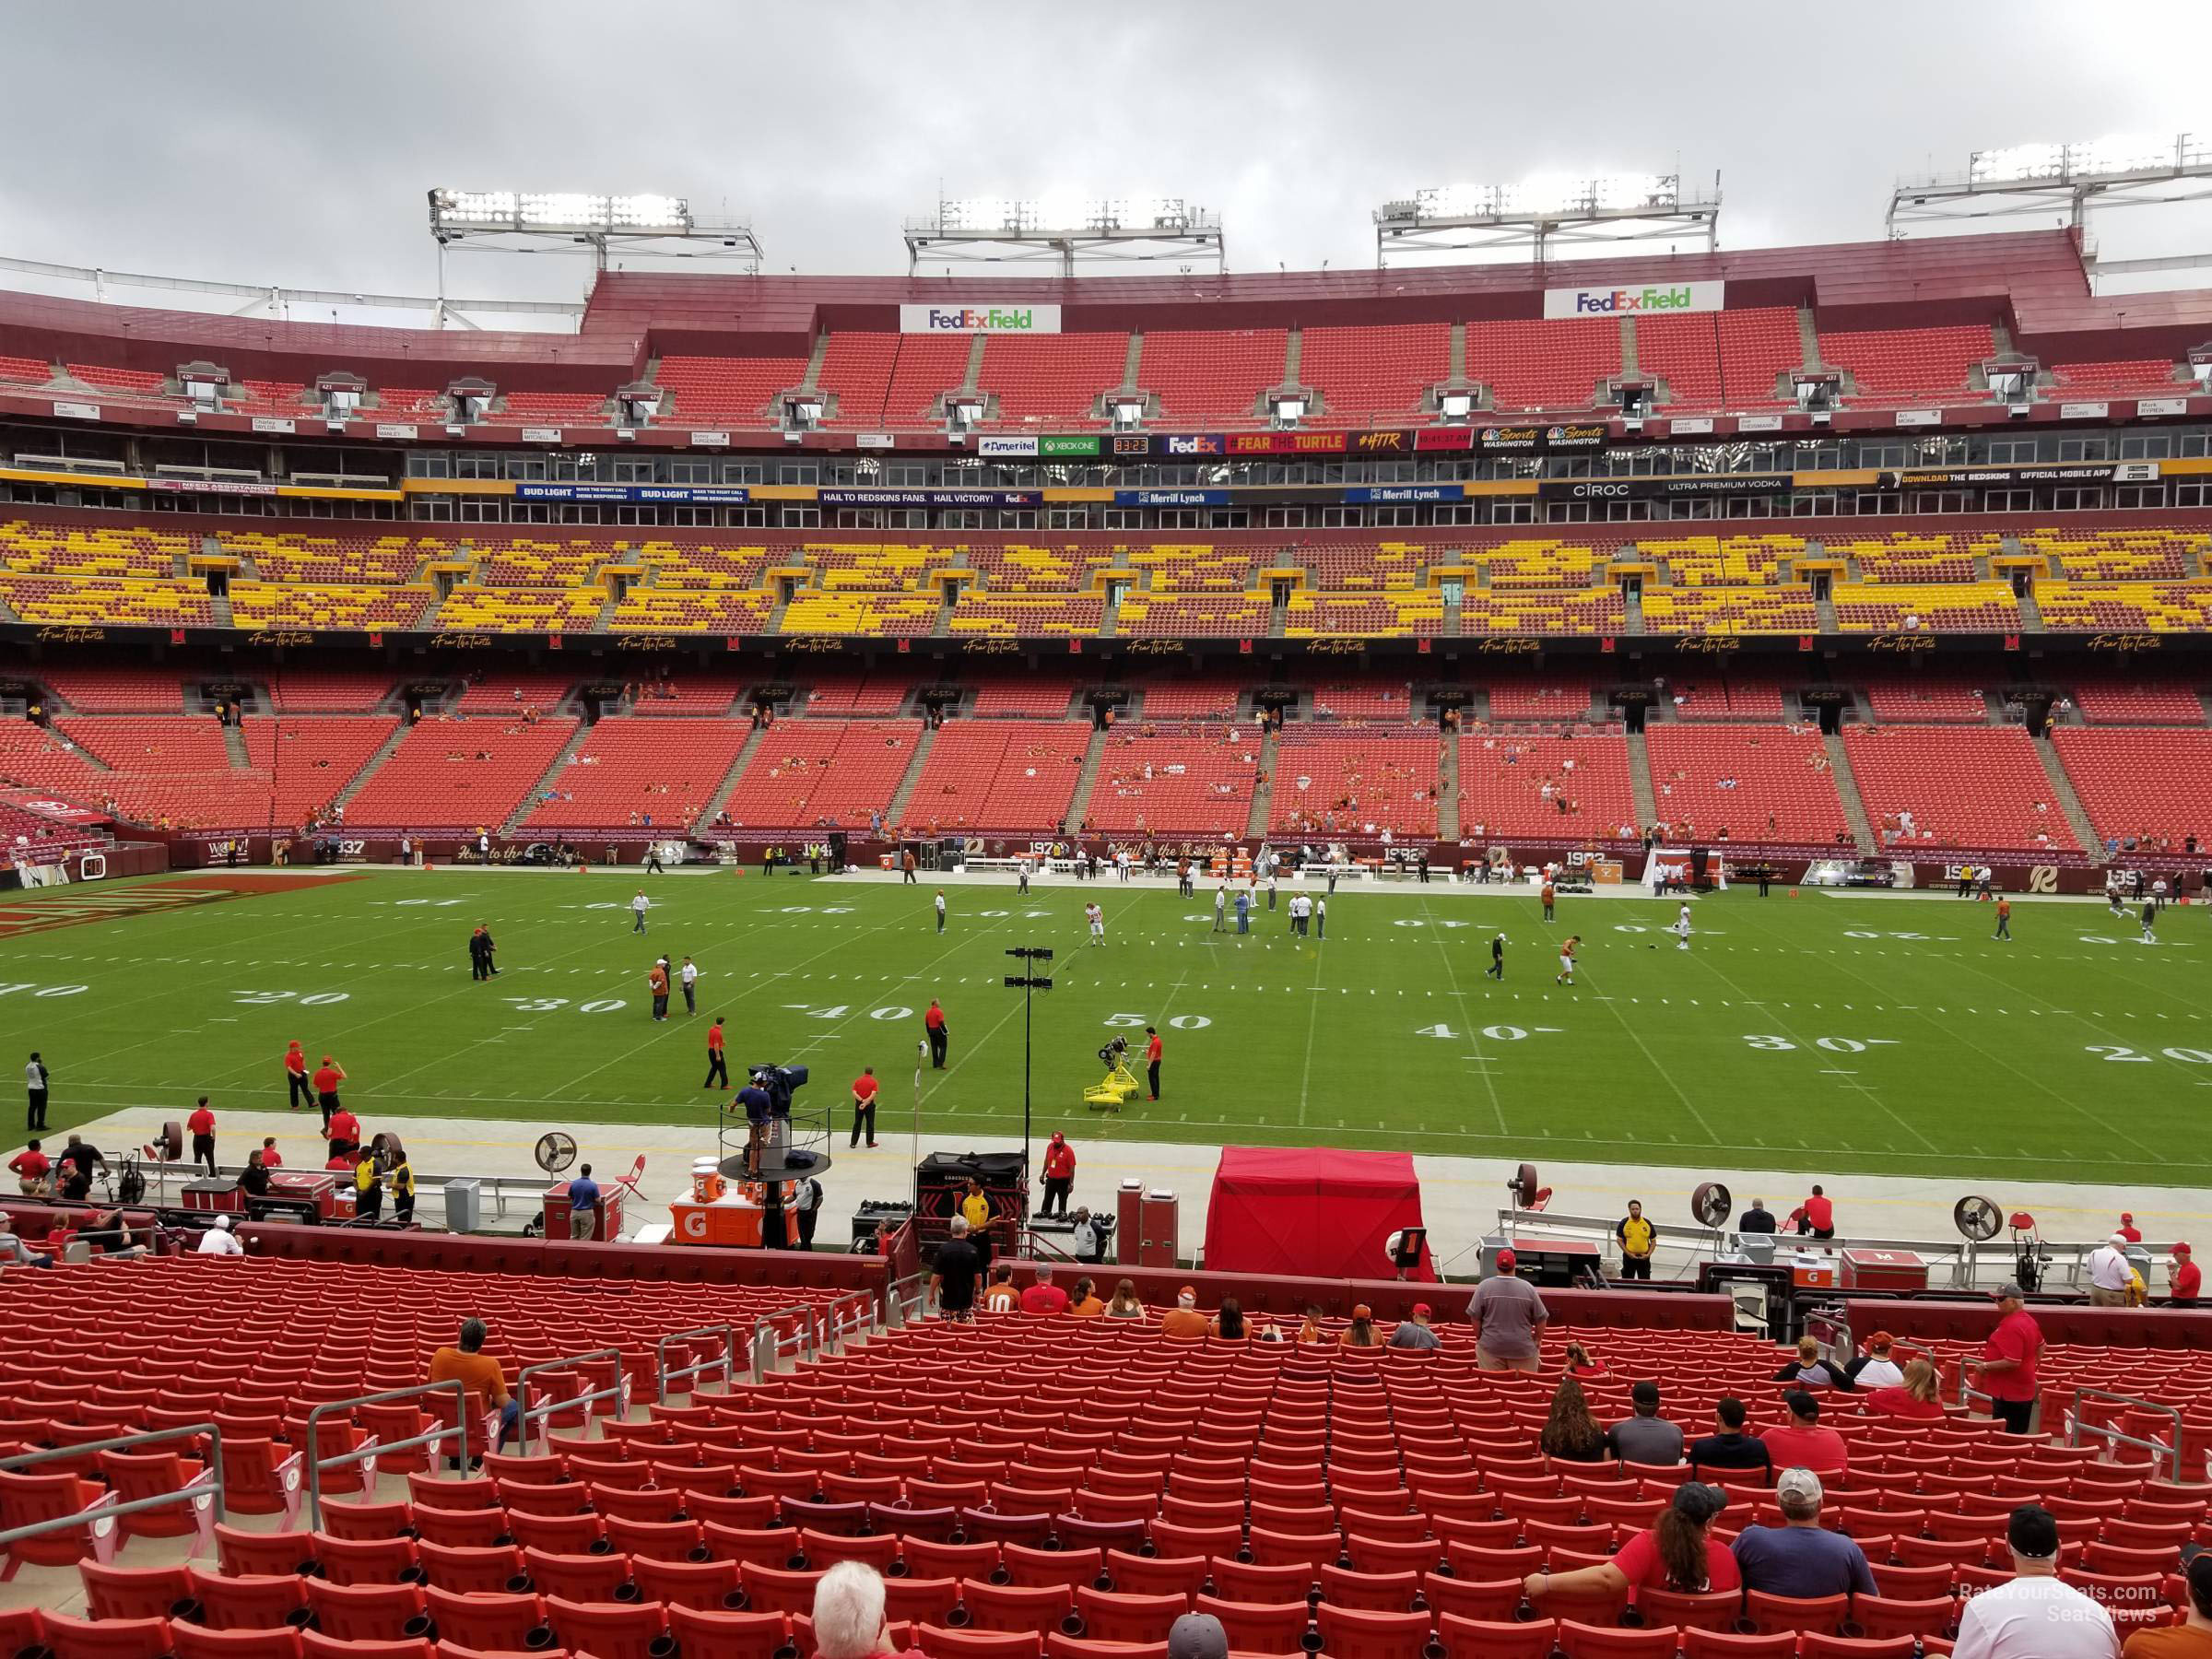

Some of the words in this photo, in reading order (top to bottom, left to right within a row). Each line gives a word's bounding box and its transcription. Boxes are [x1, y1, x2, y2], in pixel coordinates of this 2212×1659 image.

[1577, 288, 1690, 312] FedExField
[929, 309, 1032, 329] FedExField
[1499, 428, 1538, 441] Sports
[1564, 427, 1604, 439] Sports
[991, 441, 1035, 452] Ameritel
[1054, 441, 1077, 450] XBOX
[1077, 441, 1095, 450] ONE
[1169, 437, 1217, 453] FedEx
[1359, 433, 1403, 451] #HTTR
[1483, 440, 1535, 448] WASHINGTON
[1548, 438, 1600, 446] WASHINGTON
[1902, 474, 1948, 483] DOWNLOAD
[1968, 472, 2011, 481] REDSKINS
[2020, 470, 2058, 479] OFFICIAL
[2059, 469, 2091, 478] MOBILE
[2093, 468, 2111, 477] APP
[1668, 482, 1698, 491] ULTRA
[1700, 481, 1747, 489] PREMIUM
[1747, 479, 1782, 488] VODKA
[524, 488, 544, 496] BUD
[545, 488, 572, 497] LIGHT
[641, 489, 662, 498] BUD
[662, 490, 689, 499] LIGHT
[823, 493, 842, 501] HAIL
[843, 493, 855, 501] TO
[857, 494, 900, 502] REDSKINS
[902, 494, 927, 502] FANS.
[934, 494, 953, 502] HAIL
[953, 494, 994, 503] VICTORY!
[1150, 493, 1178, 503] Merrill
[1180, 494, 1205, 504] Lynch
[1382, 490, 1412, 500] Merrill
[1414, 489, 1440, 500] Lynch
[1006, 495, 1028, 503] FedEx
[1158, 842, 1177, 856] the
[235, 992, 349, 1004] 20
[515, 998, 627, 1013] 30
[805, 1005, 913, 1020] 40
[1103, 1014, 1211, 1030] 50
[1415, 1023, 1528, 1040] 40
[1743, 1035, 1865, 1052] 30
[2085, 1045, 2212, 1063] 20
[345, 1204, 354, 1213] G
[684, 1211, 707, 1237] G
[1807, 1272, 1818, 1282] G
[989, 1294, 1010, 1312] 10
